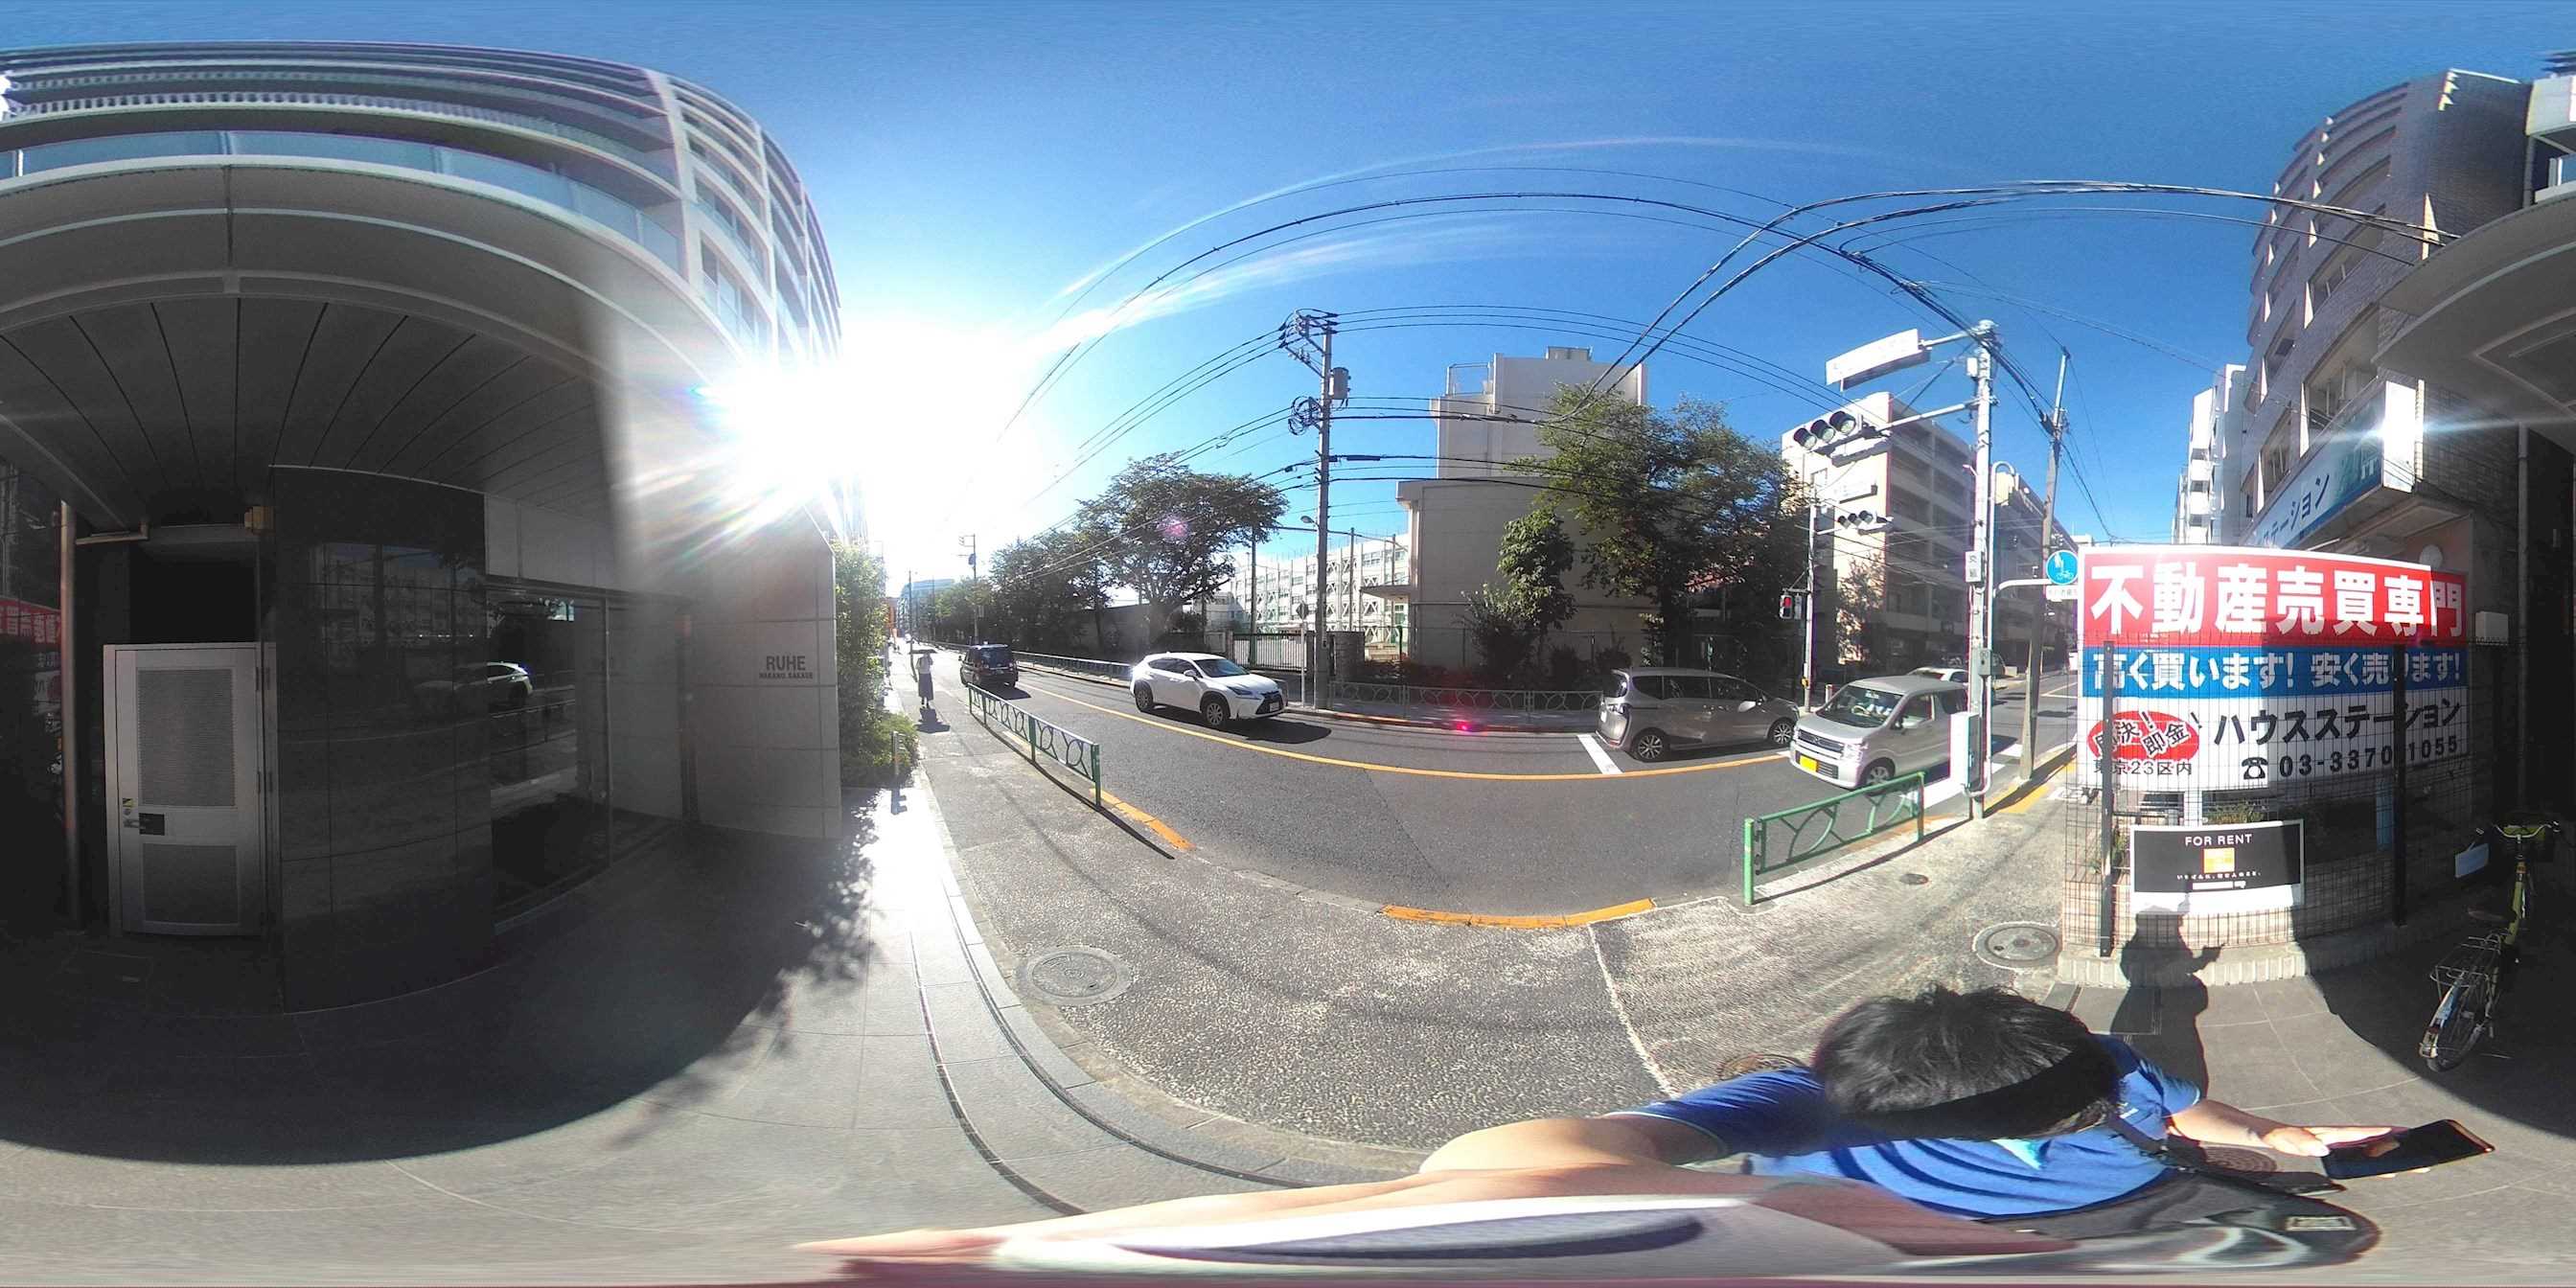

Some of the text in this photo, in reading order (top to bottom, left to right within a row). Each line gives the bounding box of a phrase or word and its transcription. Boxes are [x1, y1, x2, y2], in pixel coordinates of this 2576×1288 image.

[2090, 562, 2464, 637] 不動産売買専門
[766, 656, 806, 671] RUHE
[2279, 735, 2458, 778] 03-33701055
[2185, 834, 2253, 846] FOR RENT
